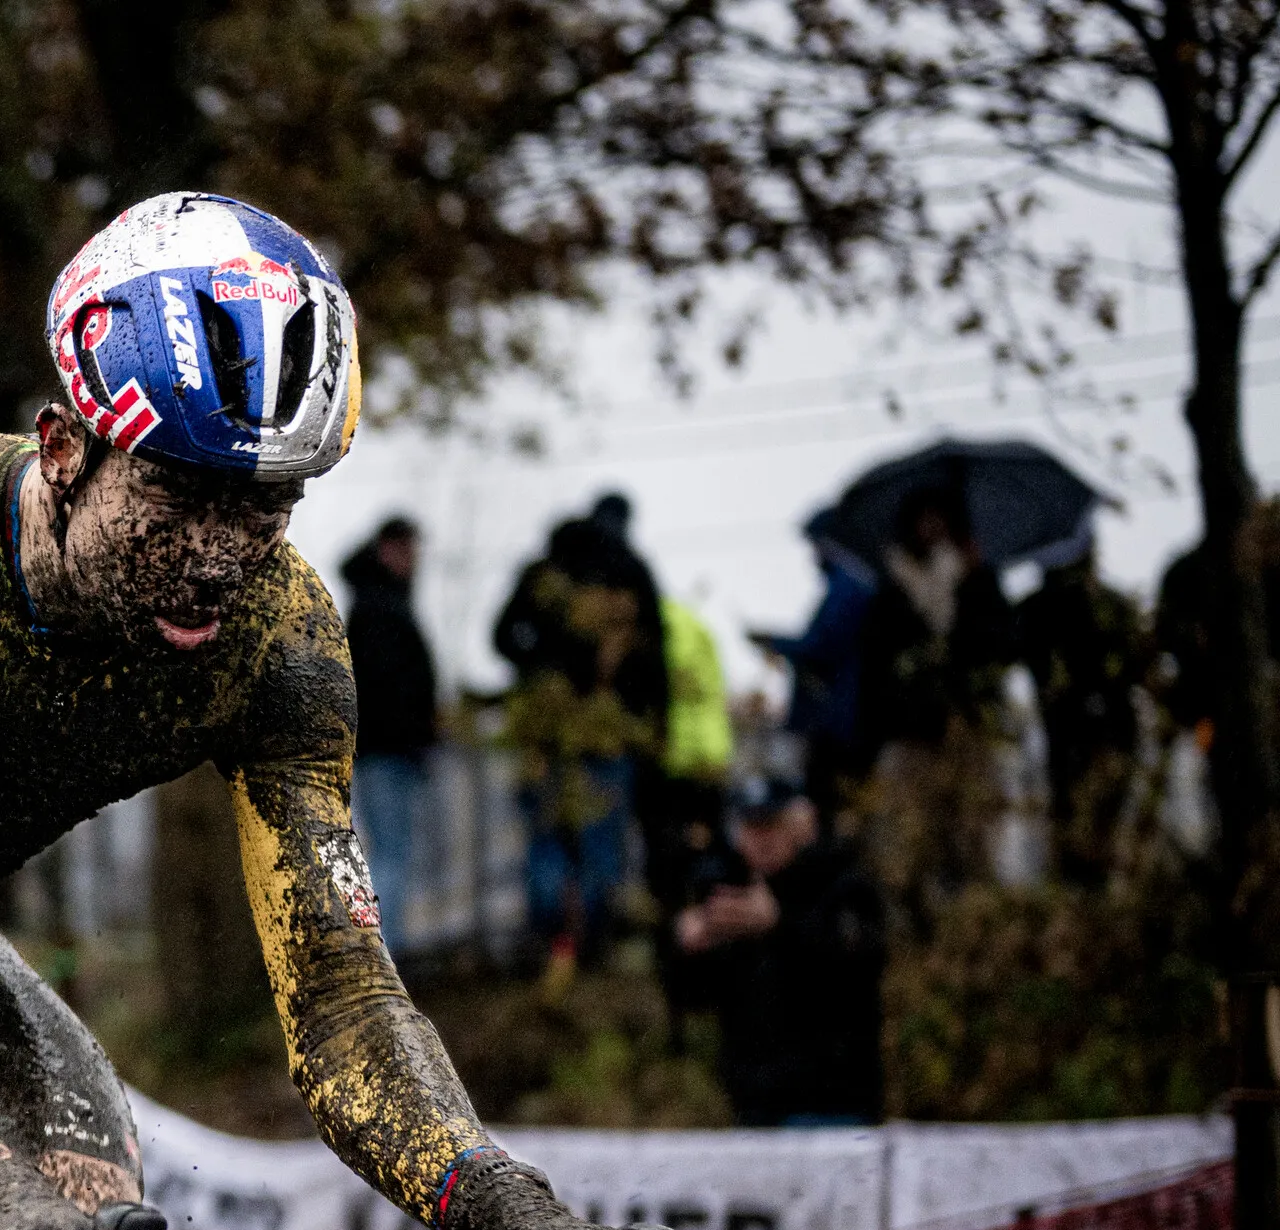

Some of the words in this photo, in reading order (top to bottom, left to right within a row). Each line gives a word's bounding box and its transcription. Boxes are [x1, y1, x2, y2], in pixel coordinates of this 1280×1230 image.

[214, 281, 259, 302] Red
[262, 282, 298, 307] Bull
[159, 276, 203, 391] LAZER
[230, 440, 283, 455] LAZER
